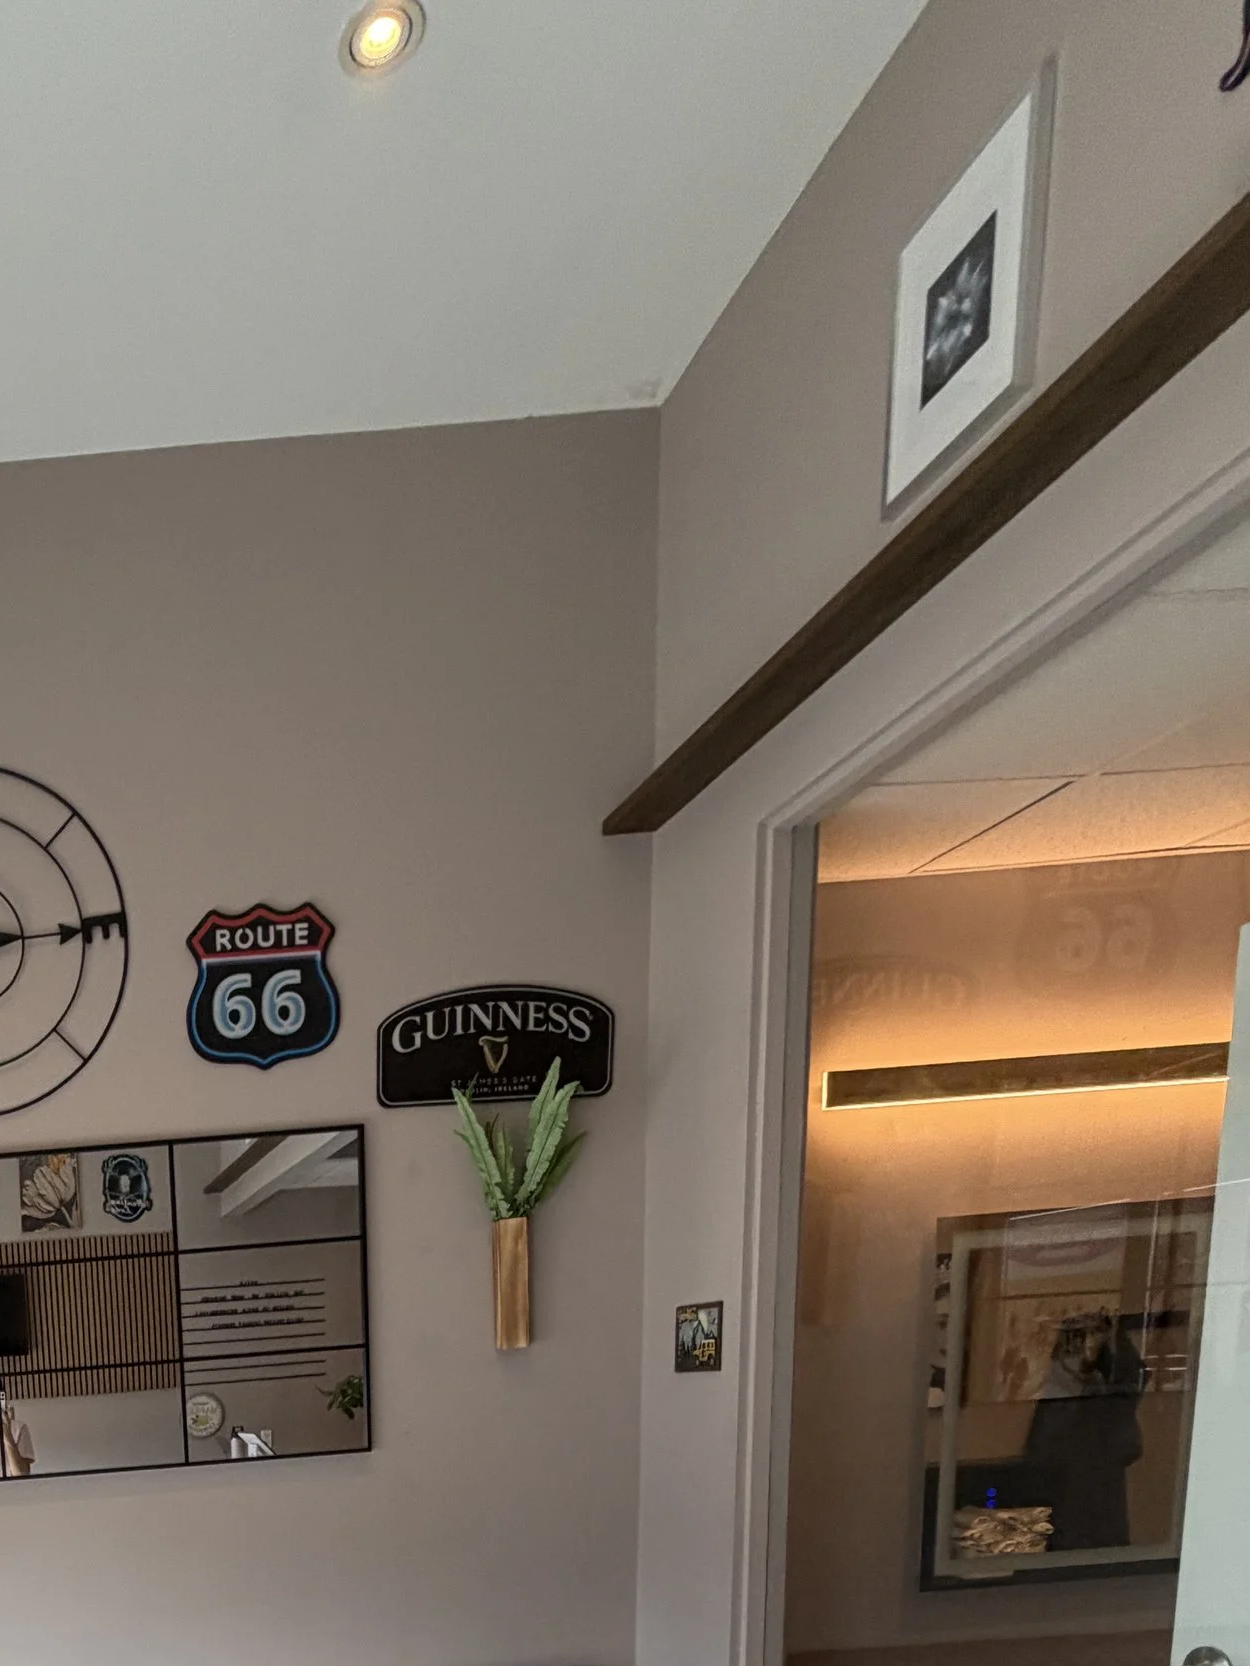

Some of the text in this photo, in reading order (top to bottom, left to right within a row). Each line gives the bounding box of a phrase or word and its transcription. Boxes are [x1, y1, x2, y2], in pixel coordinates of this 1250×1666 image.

[81, 912, 126, 945] E
[215, 922, 309, 951] ROUTE
[212, 969, 306, 1040] 66
[391, 1001, 591, 1055] GUINNESS
[494, 1083, 529, 1092] IRELAND
